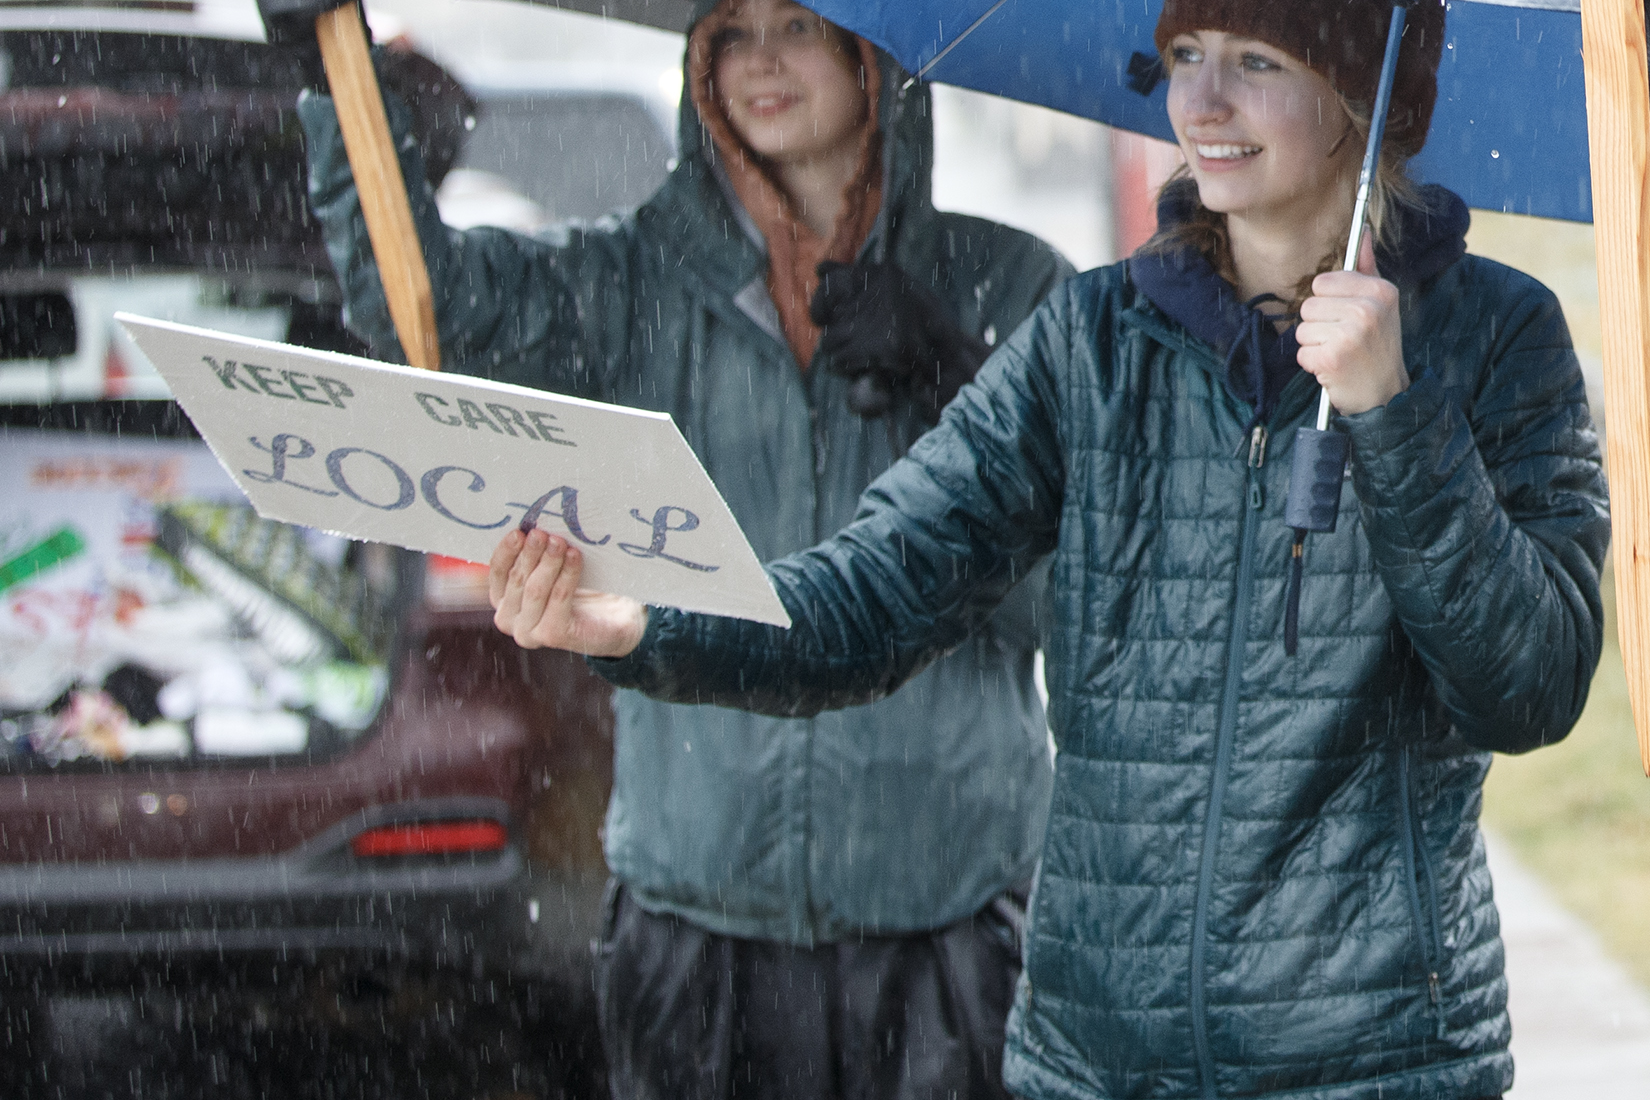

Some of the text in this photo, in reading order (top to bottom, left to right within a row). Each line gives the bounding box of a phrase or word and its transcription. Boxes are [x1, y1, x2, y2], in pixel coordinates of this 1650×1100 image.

[202, 353, 577, 448] KEEP CARE
[243, 433, 721, 574] LOCAL
